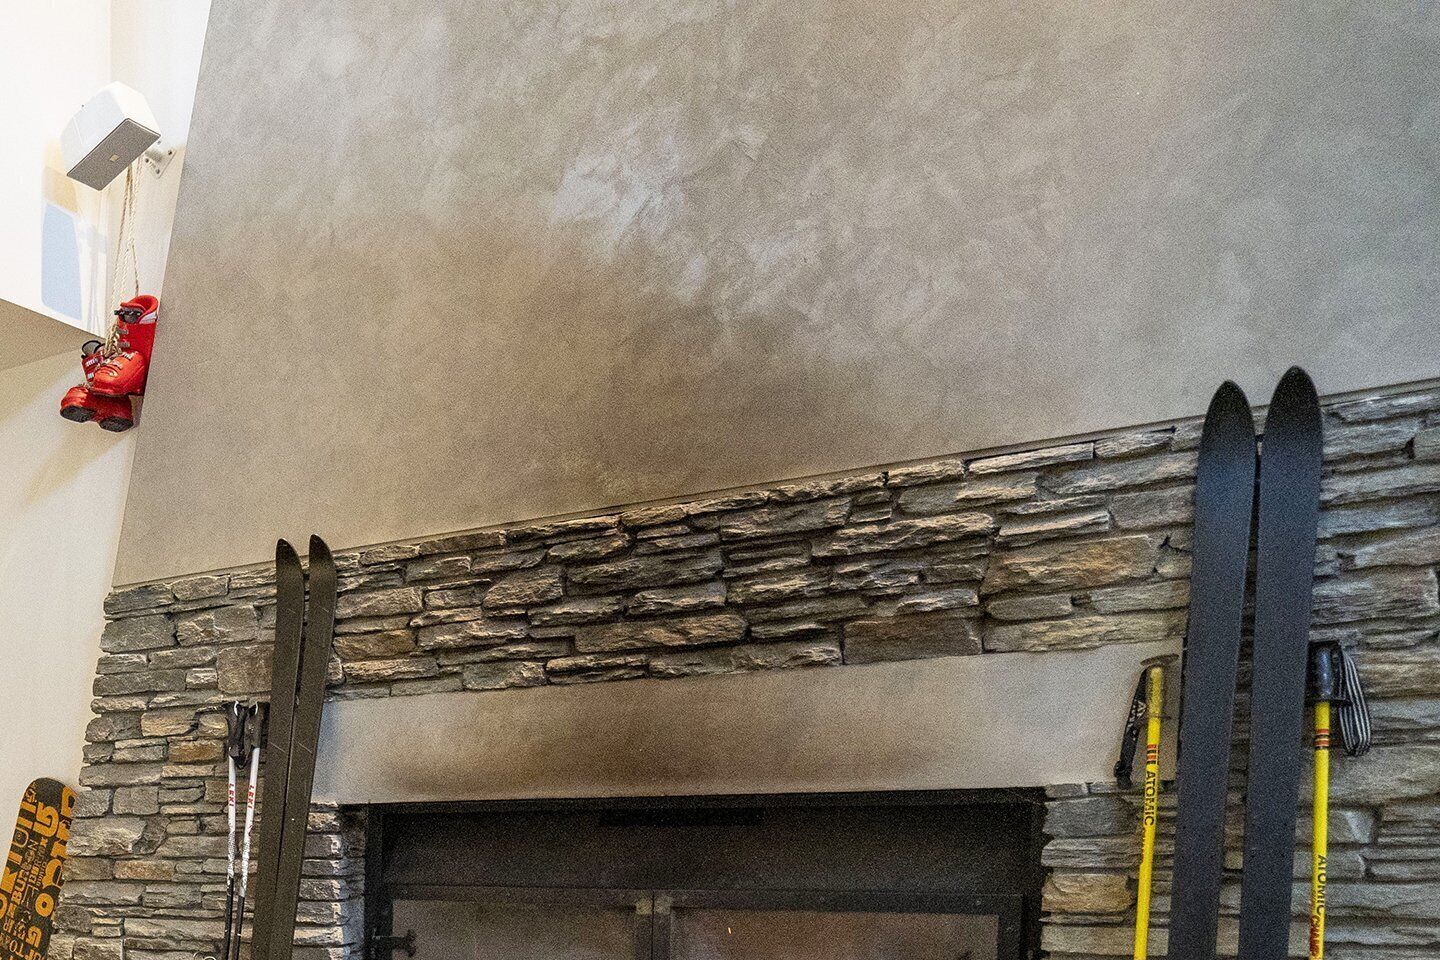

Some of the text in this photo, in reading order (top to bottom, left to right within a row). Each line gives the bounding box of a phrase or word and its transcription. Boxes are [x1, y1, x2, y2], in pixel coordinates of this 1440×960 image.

[228, 783, 236, 807] LEKI
[247, 785, 256, 809] LEKI
[1143, 770, 1157, 826] ATOMIC
[1316, 853, 1328, 917] ATOMIC
